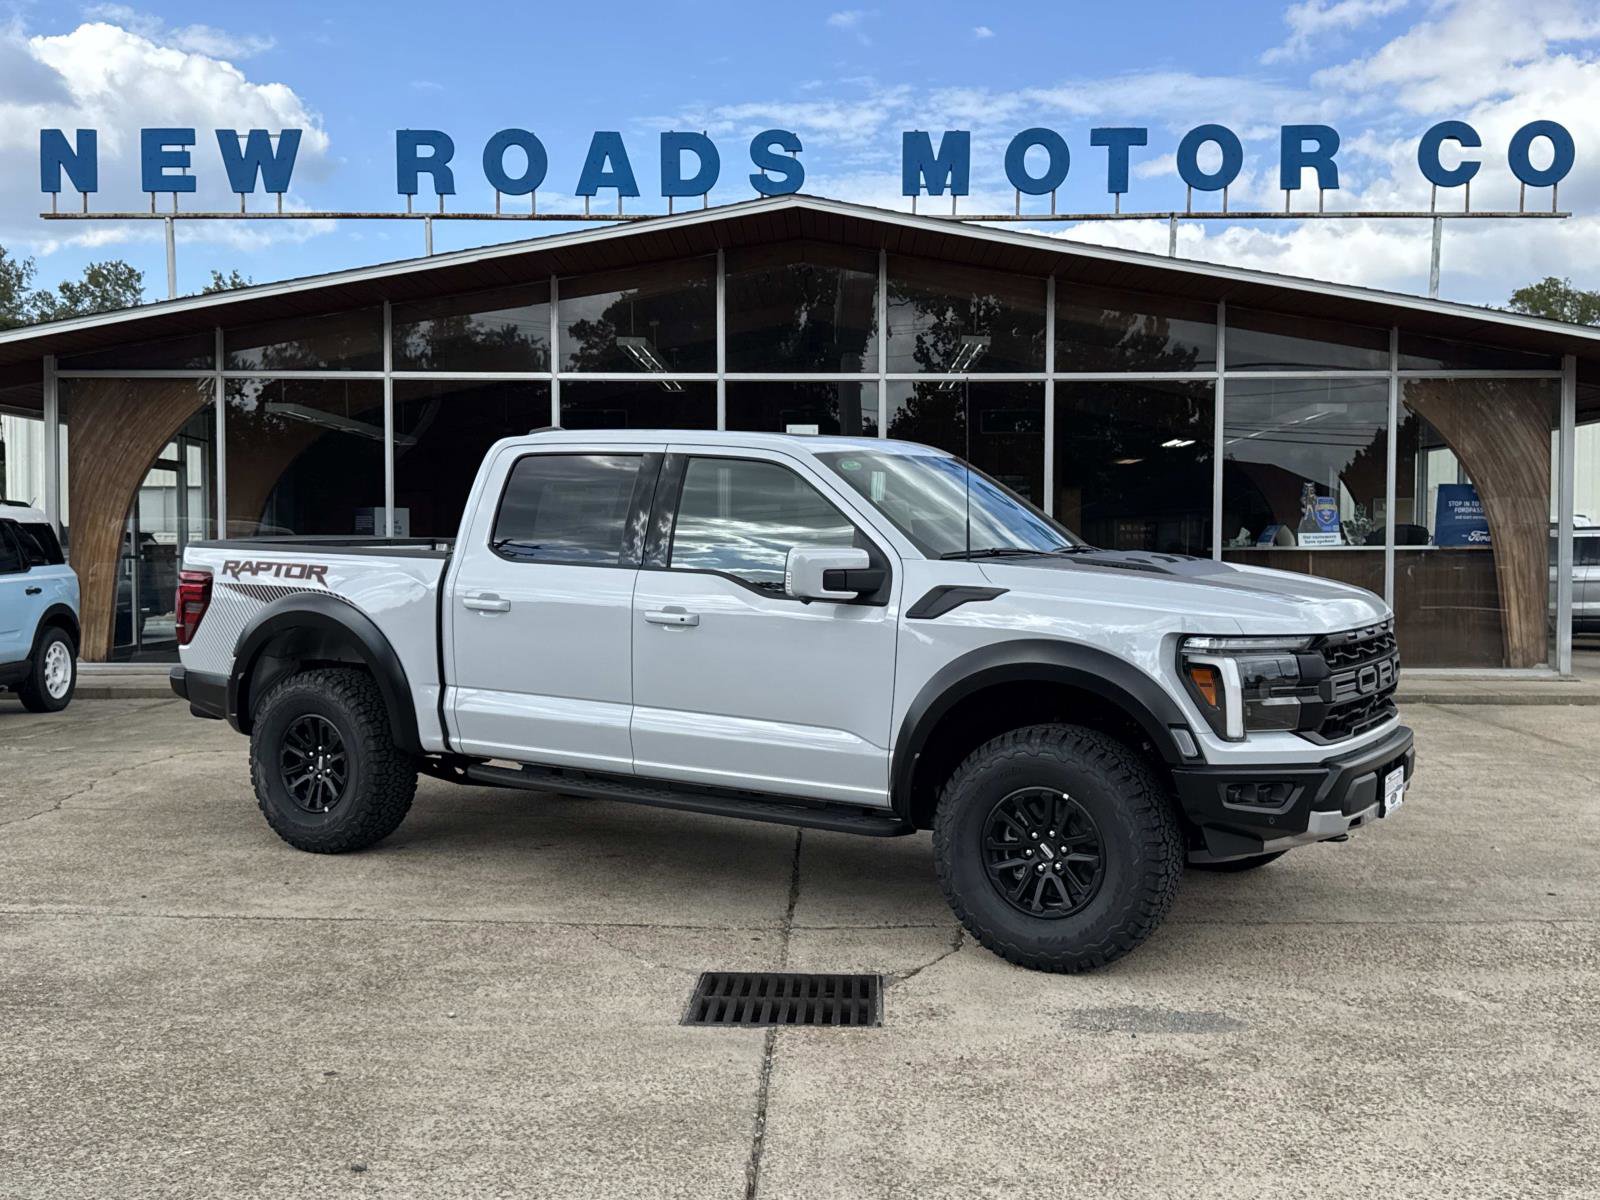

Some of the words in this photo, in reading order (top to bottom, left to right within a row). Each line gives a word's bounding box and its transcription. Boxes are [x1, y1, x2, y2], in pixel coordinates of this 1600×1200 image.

[40, 127, 302, 194] NEW
[396, 127, 806, 199] ROADS
[902, 124, 1342, 197] MOTOR
[1418, 120, 1575, 188] CO
[221, 559, 329, 589] RAPTOR
[1329, 654, 1400, 702] FORD
